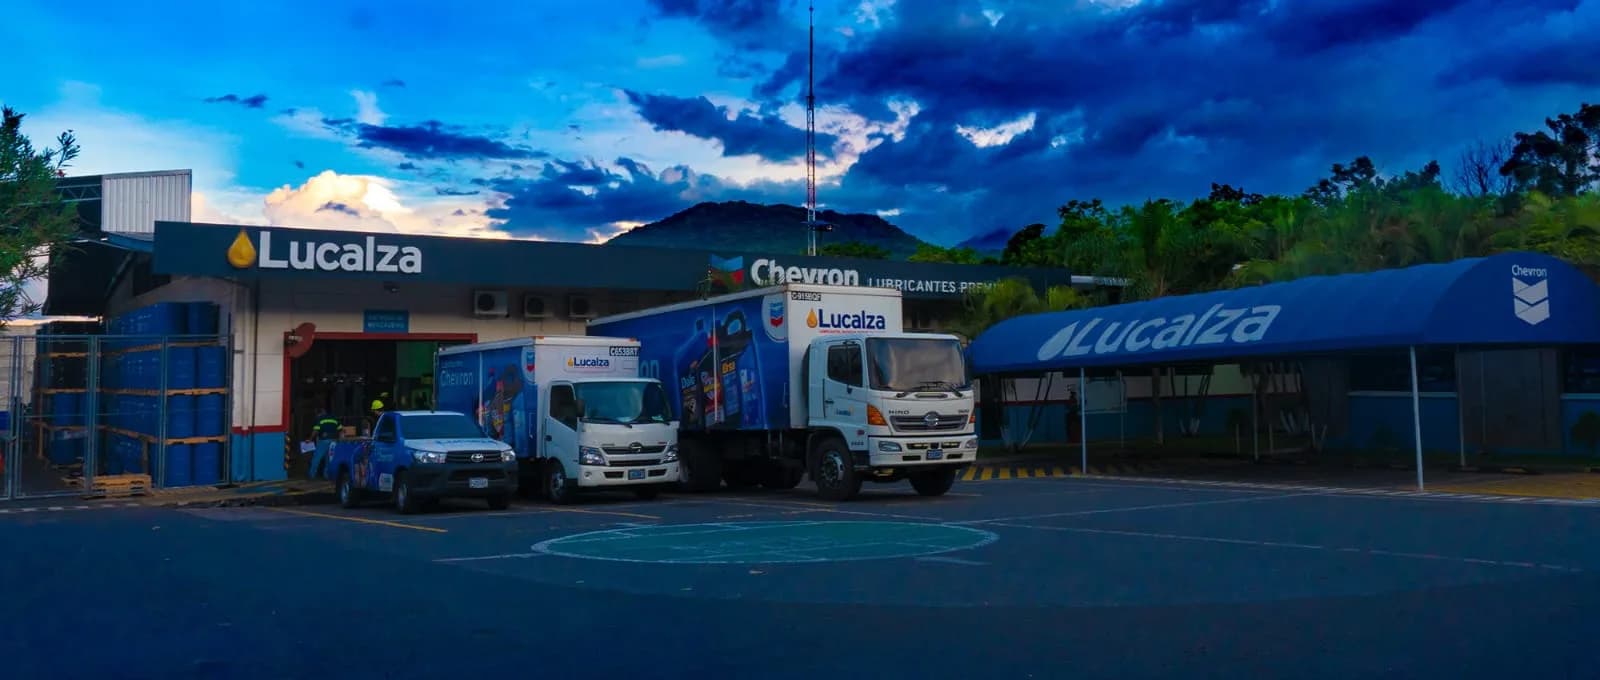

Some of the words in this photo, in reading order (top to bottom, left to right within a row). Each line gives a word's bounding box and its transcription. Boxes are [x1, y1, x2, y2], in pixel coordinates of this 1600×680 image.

[258, 231, 422, 273] Lucalza
[751, 258, 859, 287] Chevron
[1511, 264, 1548, 277] Chevron
[868, 277, 956, 293] LUBRICANTES
[818, 309, 886, 330] Lucalza
[1063, 303, 1282, 356] Lucalza
[574, 356, 610, 367] Lucalza
[440, 369, 474, 386] Chevron
